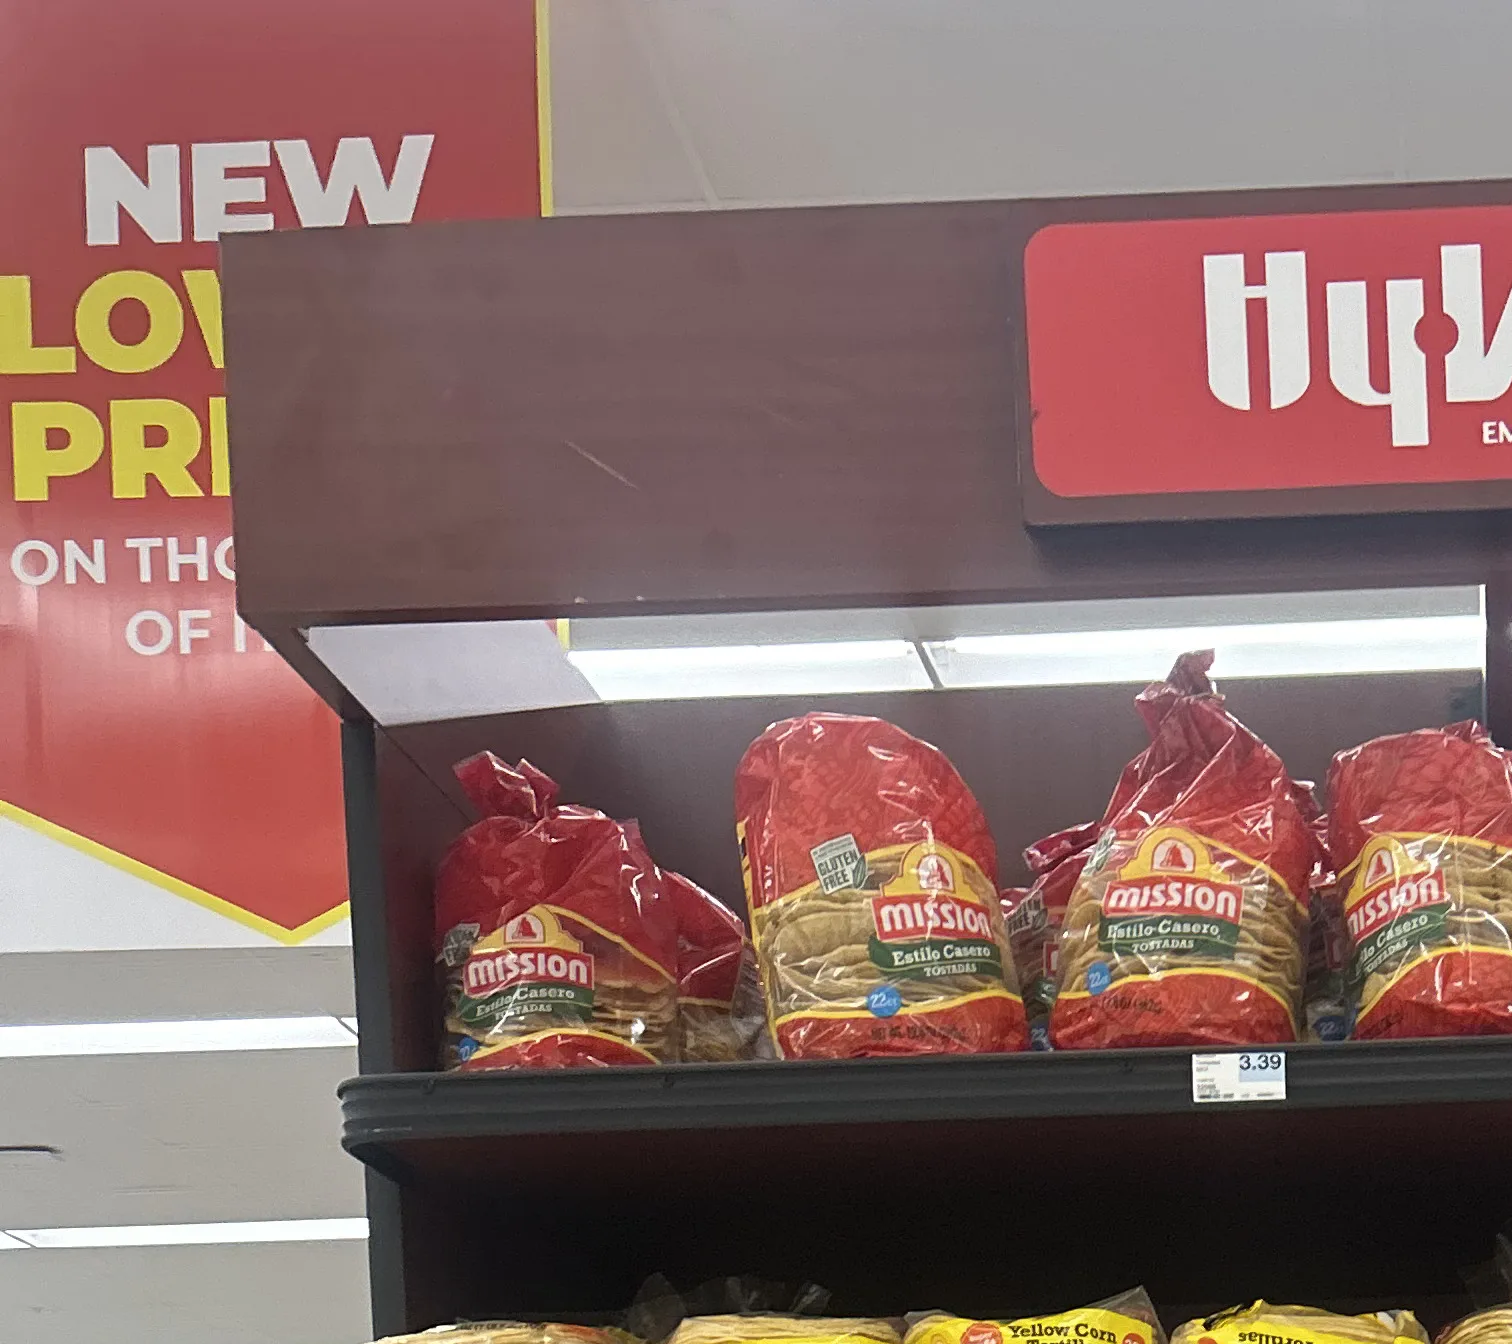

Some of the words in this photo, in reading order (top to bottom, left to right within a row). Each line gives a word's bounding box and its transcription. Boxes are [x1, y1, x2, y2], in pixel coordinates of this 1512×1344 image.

[84, 134, 434, 247] NEW
[11, 539, 105, 586] ON
[126, 611, 211, 655] OF
[892, 946, 940, 966] Estilo
[942, 944, 992, 960] Casero
[1132, 938, 1194, 951] TOSTADAS
[1239, 1054, 1282, 1072] 3.39
[1008, 1322, 1071, 1339] Yellow
[1074, 1323, 1117, 1343] Corn
